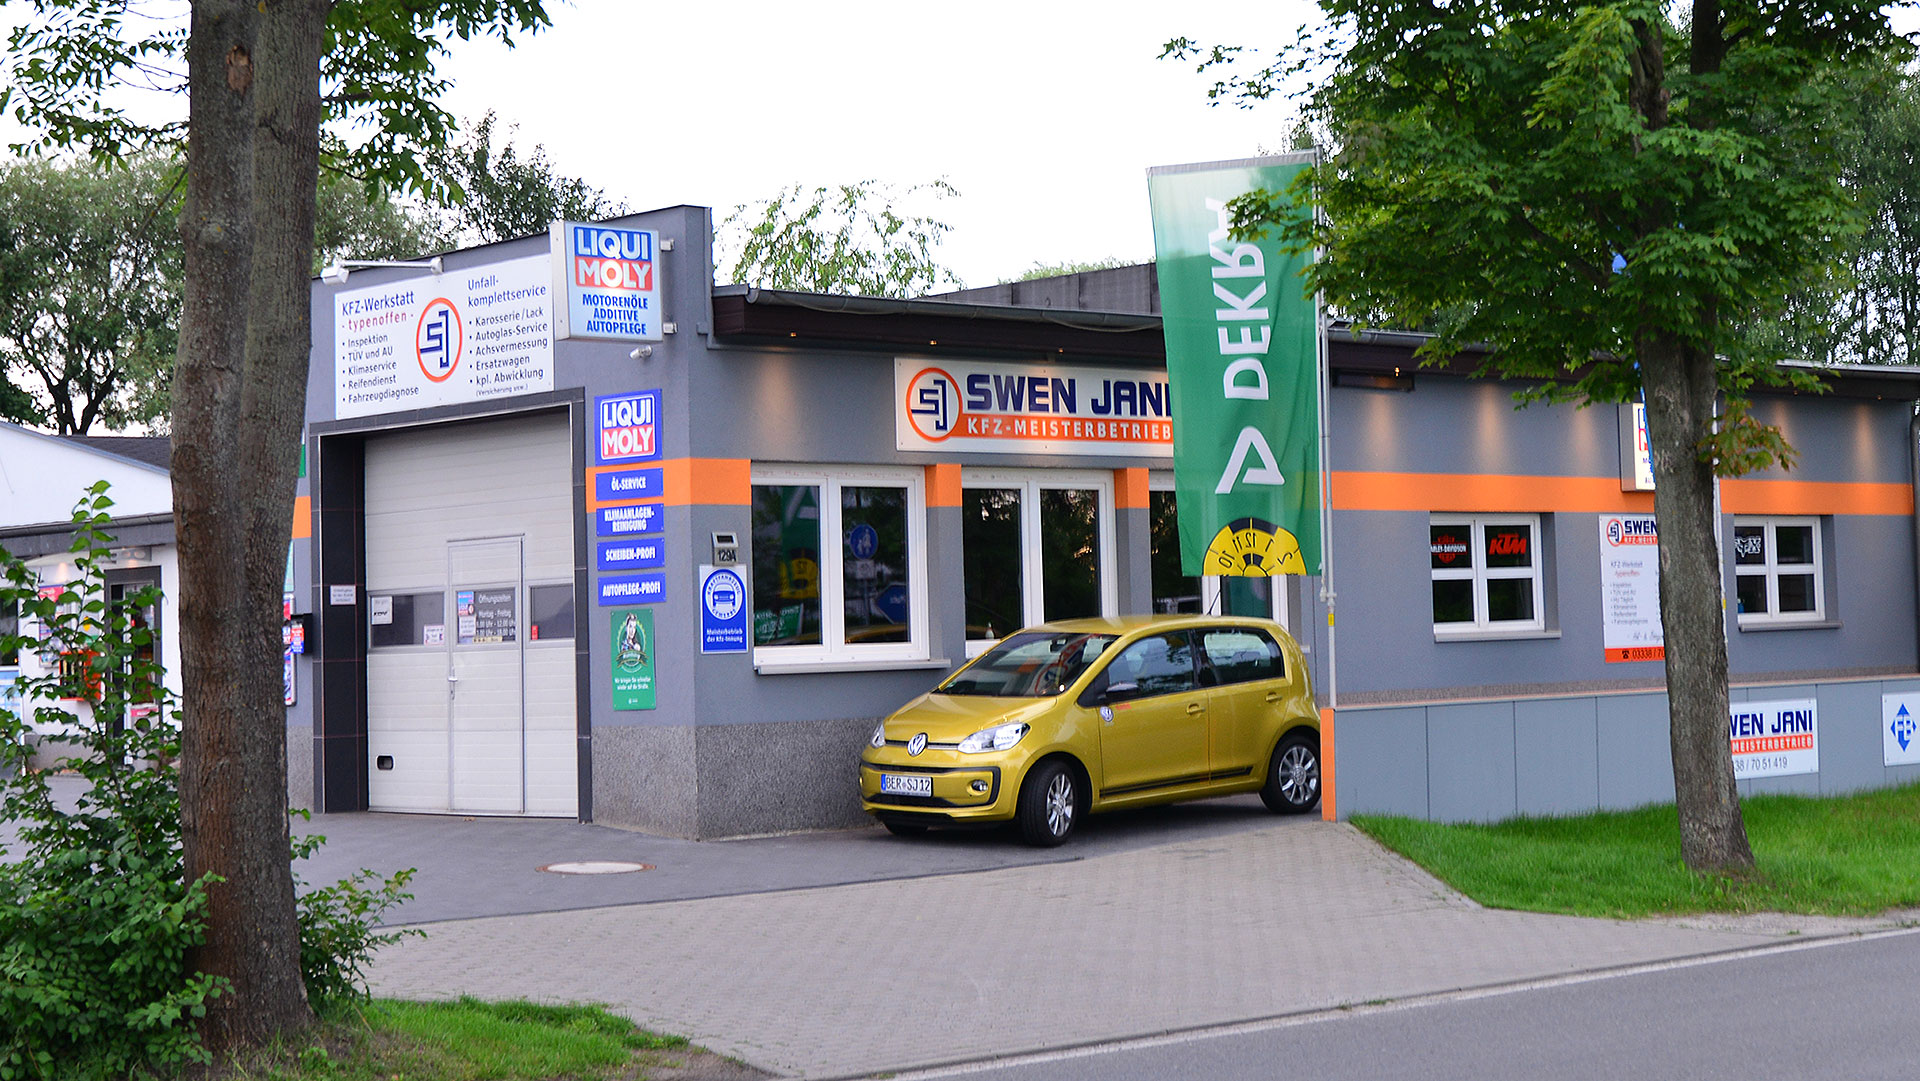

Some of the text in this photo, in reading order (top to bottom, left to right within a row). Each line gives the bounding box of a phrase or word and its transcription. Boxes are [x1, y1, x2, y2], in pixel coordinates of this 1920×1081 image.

[577, 228, 649, 260] LIQUI
[578, 259, 651, 289] MOLY
[467, 275, 499, 291] Unfall-
[342, 290, 415, 316] KFZ-Werkstatt
[468, 285, 547, 307] komplettservice
[582, 293, 649, 309] MOTORENÖLE
[348, 311, 407, 333] typenoffen
[593, 308, 639, 321] ADDITIVE
[475, 322, 548, 341] Autoglas-Service
[586, 320, 647, 335] AUTOPFLEGE
[348, 334, 388, 348] Inspektion
[475, 338, 548, 357] Achsvermessung
[365, 348, 380, 360] und
[382, 346, 393, 357] AU
[348, 361, 397, 376] Klimaservice
[476, 355, 530, 370] Ersatzwagen
[348, 374, 397, 390] Reifendienst
[476, 368, 544, 387] kpl. Abwicklung
[348, 386, 420, 404] Fahrzeugdiagnose
[967, 373, 1172, 417] SWEN JANI
[603, 398, 652, 428] LIQUI
[967, 416, 1171, 441] KFZ-MEISTERBETRIEB
[603, 427, 653, 455] MOLY
[611, 475, 647, 491] ÖL-SERVICE
[604, 506, 655, 521] KLIMAANLAGEN-
[612, 519, 647, 532] REINIGUNG
[1625, 520, 1658, 534] SWEN
[1431, 543, 1467, 553] ARLEY-DAVIDSON
[1488, 533, 1527, 555] KTM
[605, 546, 656, 561] SCHEIBEN-PROFI
[603, 581, 661, 597] AUTOPFLEGE-PROFI
[1730, 710, 1813, 737] WEN JANI
[1732, 735, 1812, 753] MEISTERBETRIEB
[1751, 758, 1761, 771] 70
[1773, 756, 1788, 769] 419
